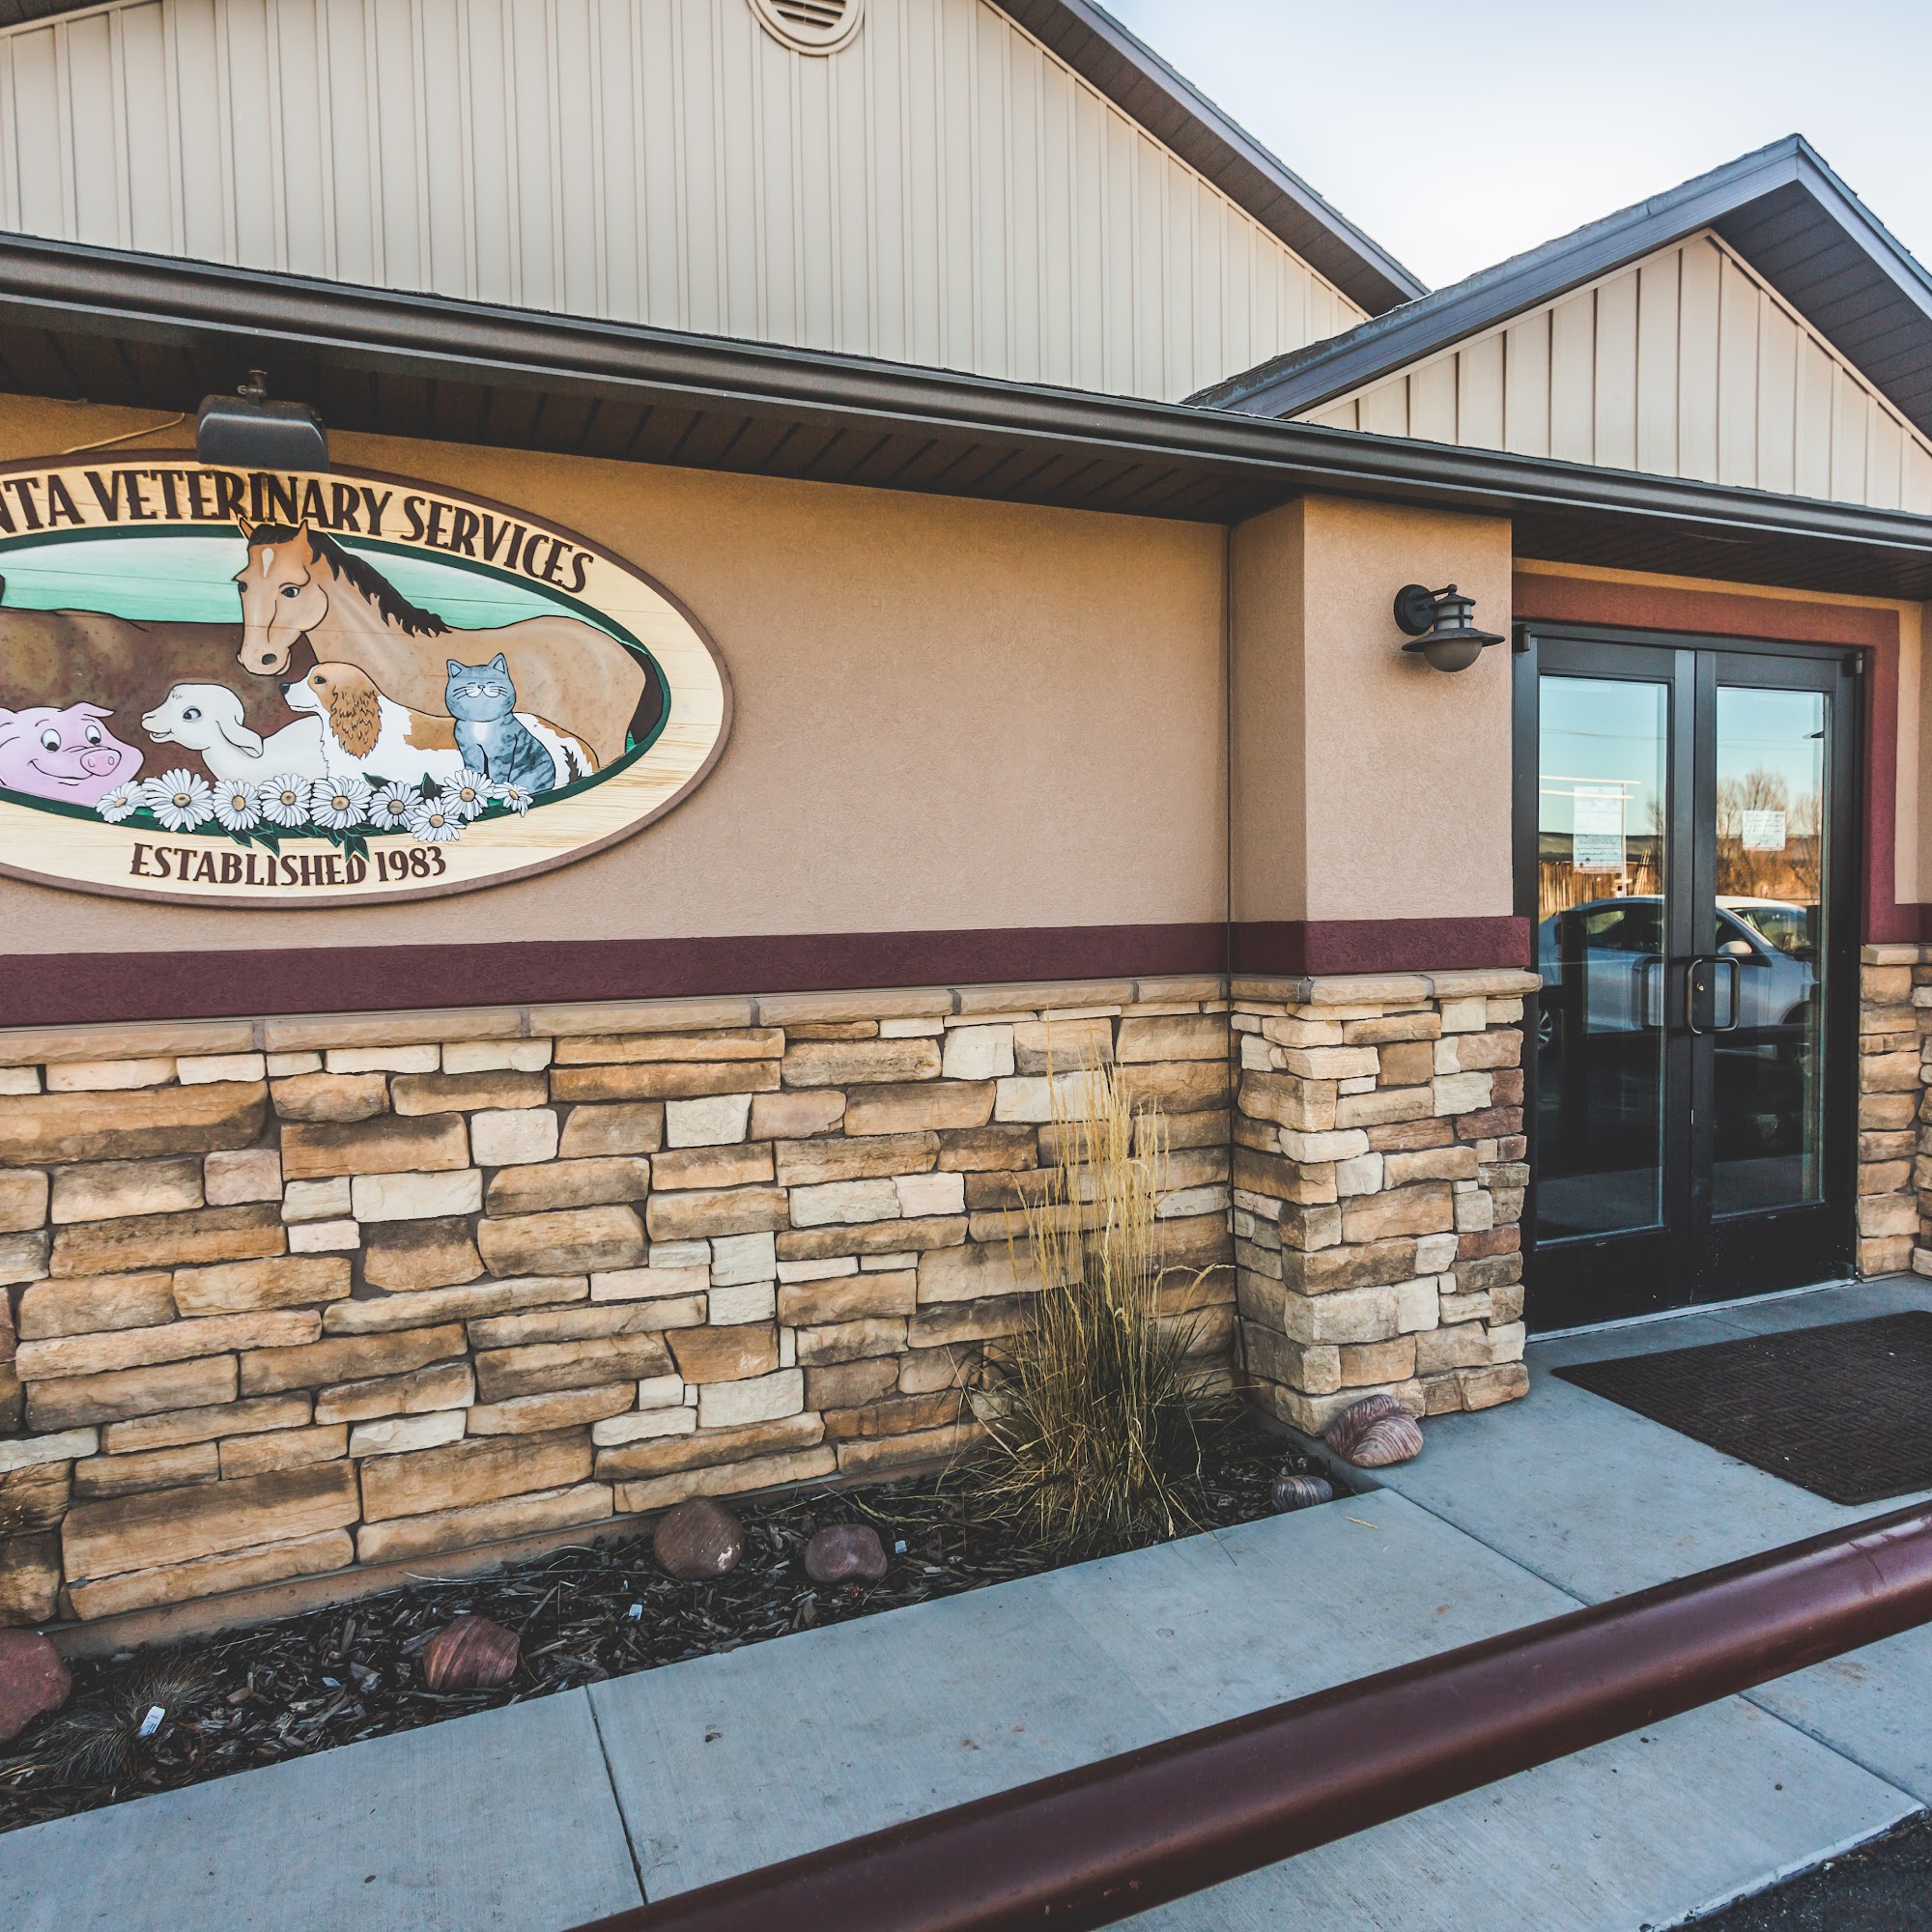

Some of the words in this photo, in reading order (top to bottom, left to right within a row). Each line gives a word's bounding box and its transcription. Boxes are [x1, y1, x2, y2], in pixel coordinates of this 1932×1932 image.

[84, 469, 392, 537] VETERINARY
[400, 496, 594, 593] SERVICES
[129, 842, 366, 887] ESTABLISHED
[374, 845, 446, 882] 1983
